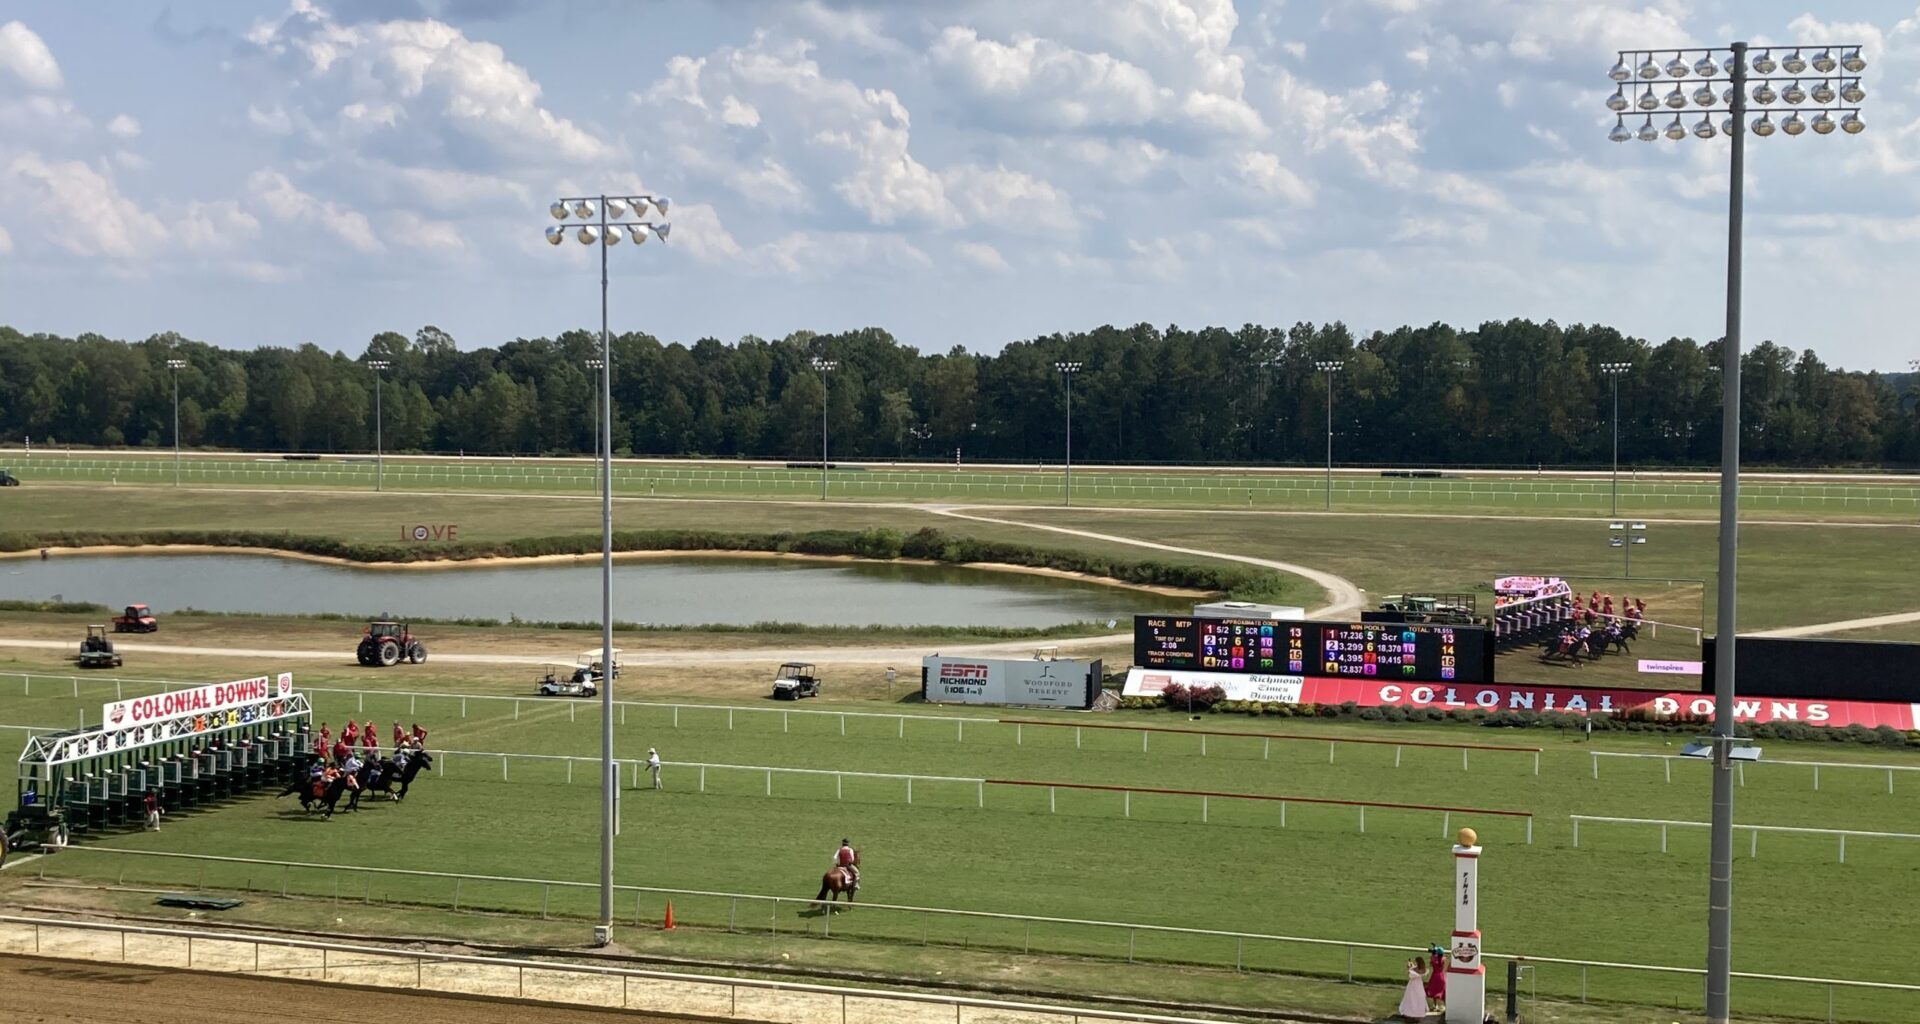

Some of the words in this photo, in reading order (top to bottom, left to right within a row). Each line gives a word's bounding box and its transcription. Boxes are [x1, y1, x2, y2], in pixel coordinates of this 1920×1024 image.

[400, 525, 458, 541] LOVE
[1207, 624, 1212, 634] 1
[1216, 626, 1230, 634] 5/2
[1235, 625, 1242, 635] 5
[1245, 627, 1258, 635] SCR
[1290, 628, 1302, 637] 13
[1206, 636, 1213, 645] 2
[1218, 637, 1228, 645] 17
[1234, 637, 1242, 646] 6
[1248, 638, 1255, 646] 2
[1262, 638, 1272, 647] 10
[1290, 639, 1302, 648] 14
[1330, 630, 1335, 639] 1
[1340, 631, 1364, 640] 17,236
[1367, 631, 1374, 641] 5
[1381, 633, 1397, 641] Scr
[1442, 634, 1454, 644] 13
[1206, 646, 1213, 656] 3
[1218, 648, 1228, 656] 13
[1248, 650, 1255, 658] 2
[1290, 650, 1302, 659] 15
[1328, 641, 1336, 650] 2
[1339, 642, 1364, 652] 3,299
[1367, 642, 1374, 652] 6
[1404, 643, 1415, 653] 10
[1442, 645, 1454, 655] 14
[1206, 658, 1213, 666] 4
[1216, 659, 1230, 667] 7/2
[1328, 651, 1336, 661] 3
[1338, 654, 1364, 663] 4,395
[1377, 655, 1402, 665] 19,415
[1442, 657, 1454, 666] 15
[940, 663, 988, 678] ESPN
[1328, 663, 1336, 672] 4
[1339, 665, 1364, 674] 12,837
[1646, 664, 1684, 673] twinspires
[939, 677, 987, 686] RICHMOND
[1023, 679, 1073, 688] WOODFORD
[1249, 674, 1302, 685] Richmond
[950, 686, 970, 694] 106.1
[1028, 687, 1070, 696] RESERVE
[131, 688, 211, 722] COLONIAL
[214, 678, 267, 706] DOWNS
[1250, 692, 1294, 702] Dispatch
[1378, 685, 1621, 713] COLONIAL
[1653, 696, 1831, 722] DOWNS
[245, 711, 251, 720] 3
[261, 708, 266, 717] 2
